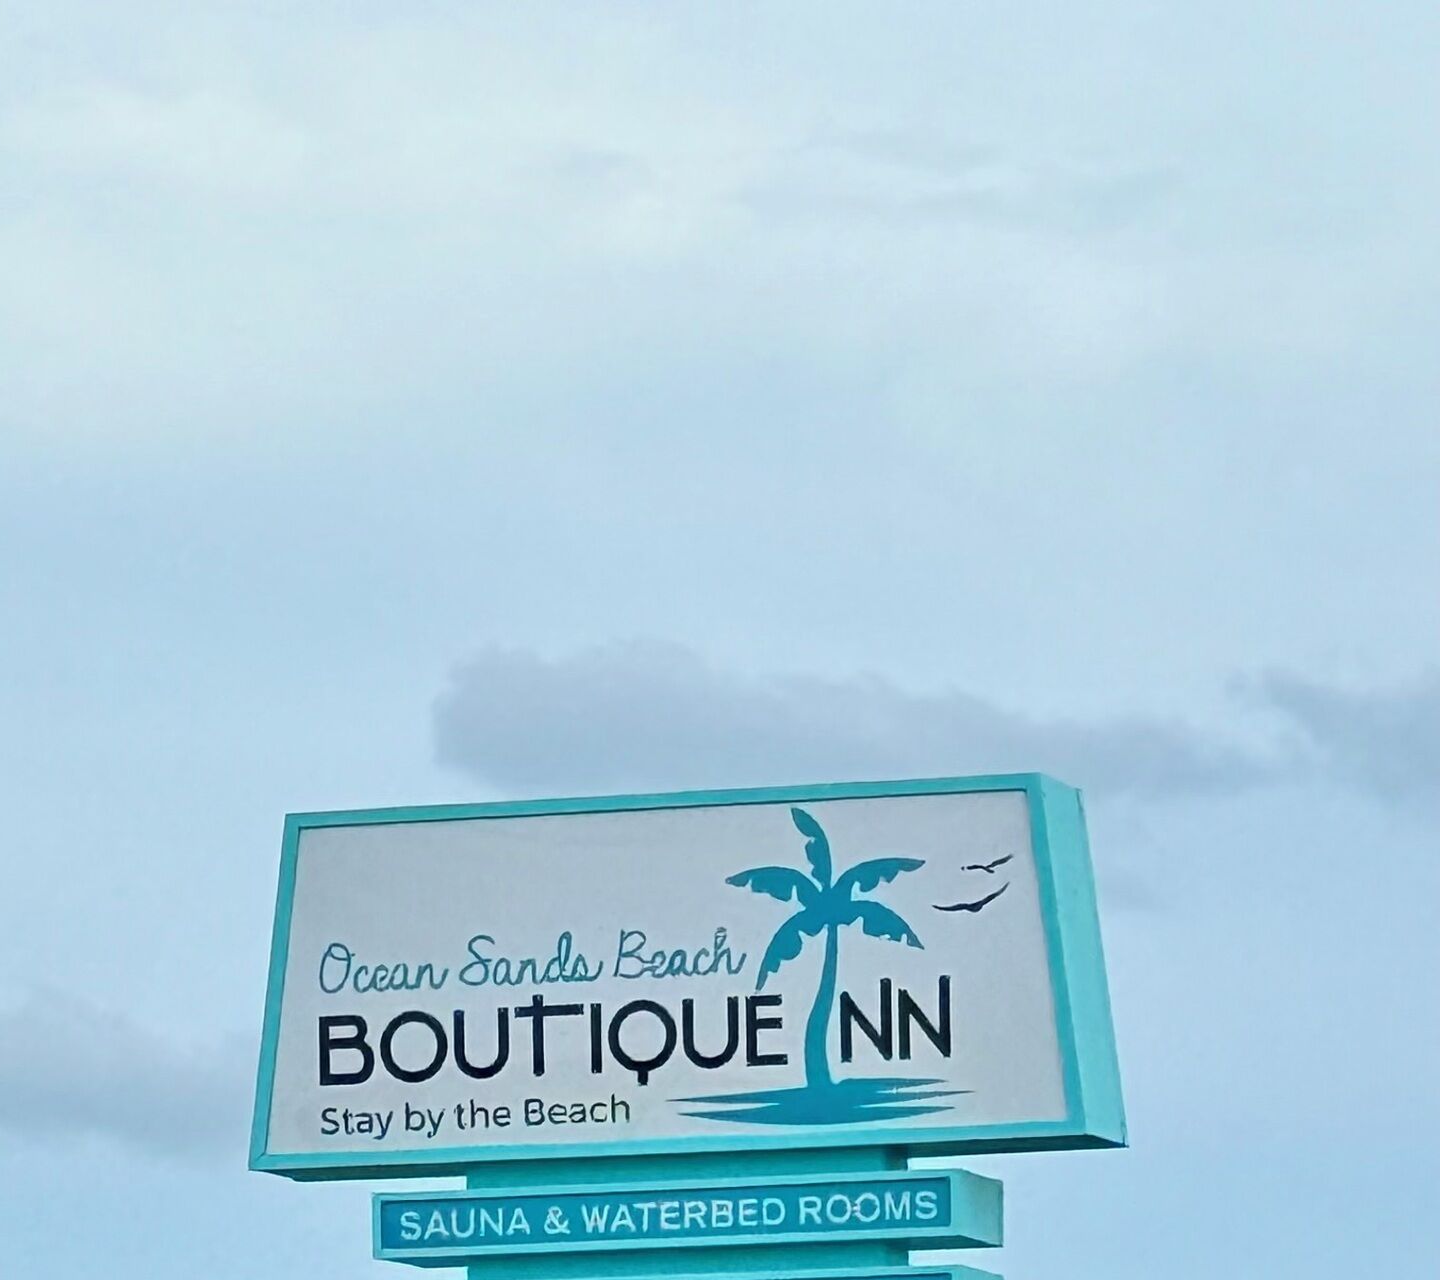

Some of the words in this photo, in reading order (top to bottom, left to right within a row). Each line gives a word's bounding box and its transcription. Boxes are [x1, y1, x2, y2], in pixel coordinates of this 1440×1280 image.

[318, 942, 448, 995] Ocean
[461, 934, 603, 988] Sands
[613, 928, 747, 980] Beach
[318, 992, 789, 1087] BOUTIQUE
[321, 1104, 393, 1140] Stay
[404, 1101, 445, 1140] by
[455, 1100, 512, 1130] the
[525, 1095, 630, 1127] Beach
[400, 1206, 530, 1241] SAUNA
[544, 1207, 570, 1234] &
[581, 1197, 784, 1235] WATERBED
[798, 1191, 937, 1225] ROOMS
